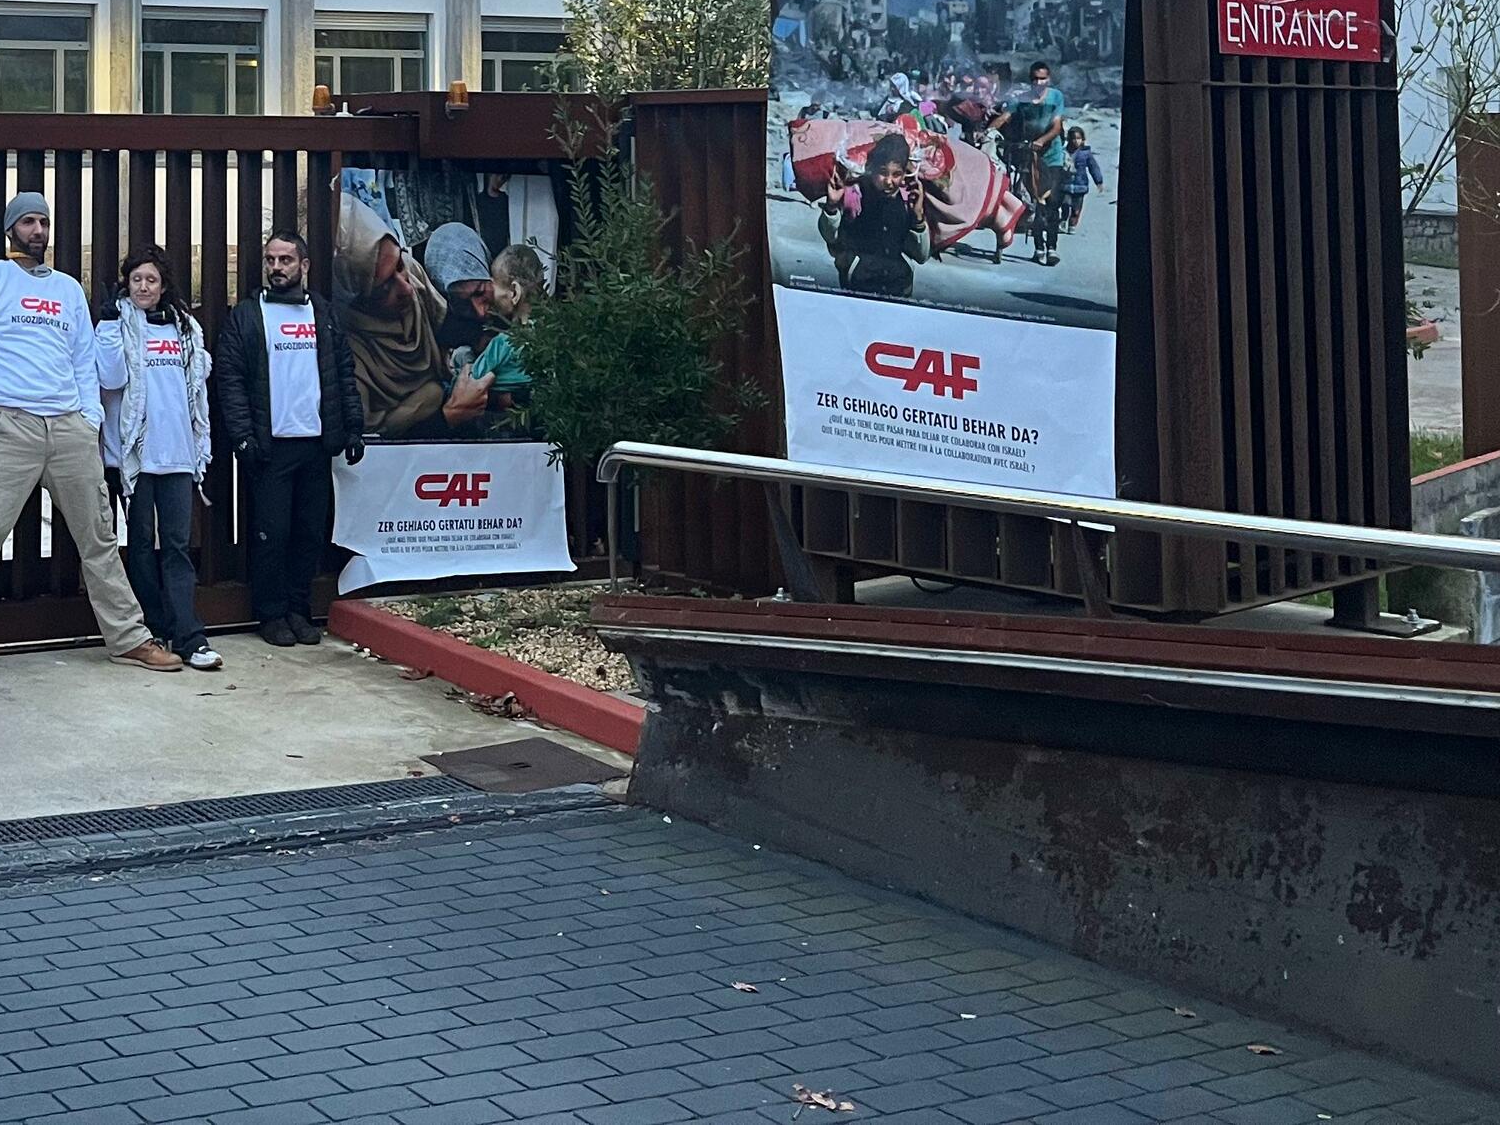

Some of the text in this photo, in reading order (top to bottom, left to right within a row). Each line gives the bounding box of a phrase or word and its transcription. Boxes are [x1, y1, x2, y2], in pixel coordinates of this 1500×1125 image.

[1226, 2, 1358, 49] ENTRANCE
[21, 298, 61, 316] CAF
[865, 341, 980, 400] CAF
[817, 392, 1039, 445] ZER GEHIAGO GERTATU BEHAR DA?
[415, 473, 490, 507] CAF
[378, 517, 523, 532] ZER GEHIAGO GERTATU BEHAR DA?
